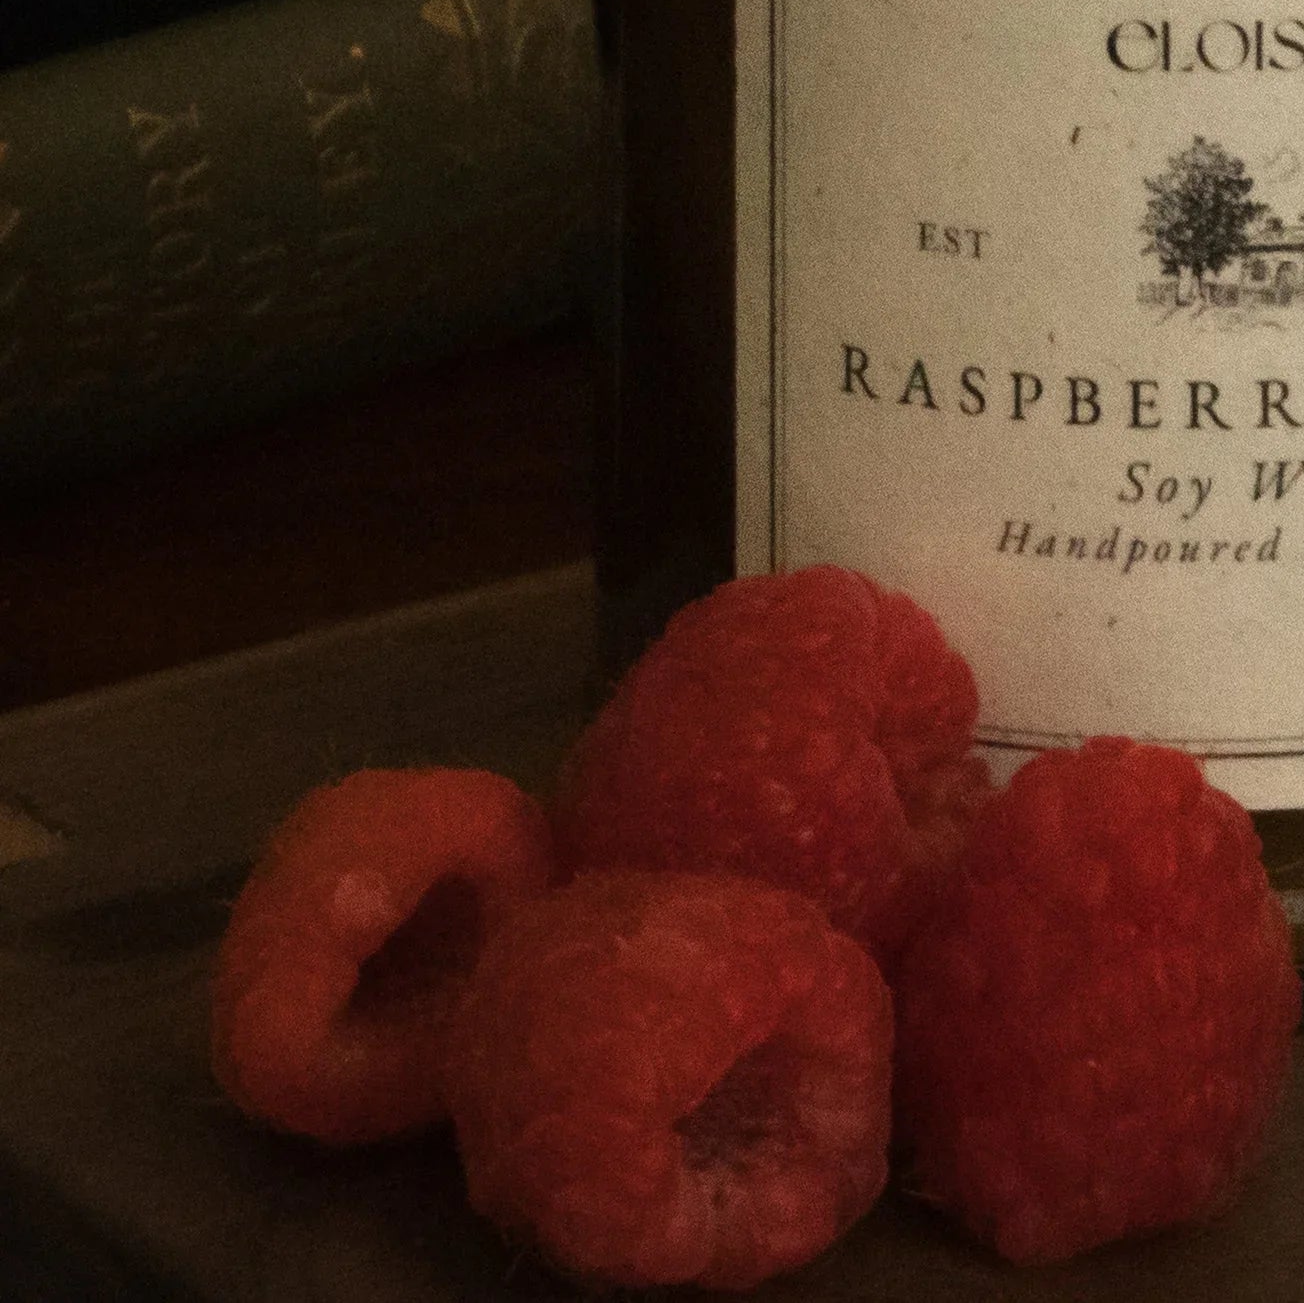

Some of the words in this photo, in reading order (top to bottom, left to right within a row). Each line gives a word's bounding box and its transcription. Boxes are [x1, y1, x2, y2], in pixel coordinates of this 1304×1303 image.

[914, 220, 991, 260] EST
[1116, 460, 1214, 522] Soy
[995, 519, 1285, 575] Handpoured
